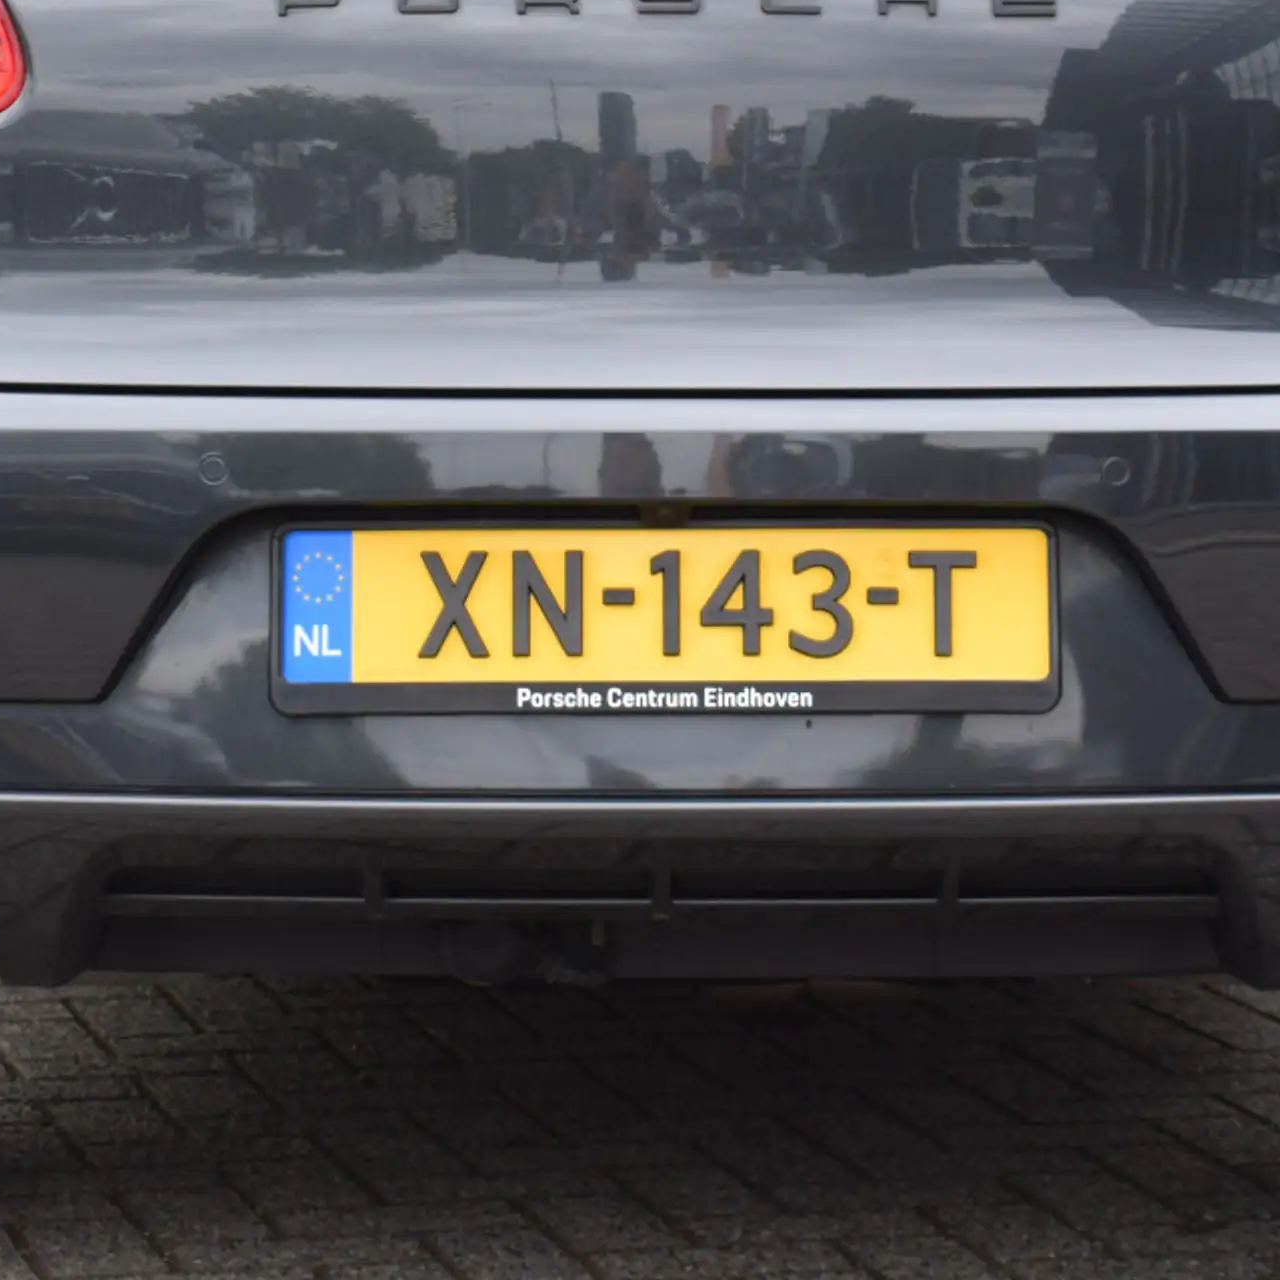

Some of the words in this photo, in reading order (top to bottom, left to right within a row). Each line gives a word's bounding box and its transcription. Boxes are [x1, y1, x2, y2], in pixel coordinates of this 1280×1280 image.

[418, 549, 977, 658] XN-143-T
[293, 625, 341, 656] NL
[516, 687, 602, 708] Porsche
[607, 687, 699, 708] Centrum
[704, 687, 813, 708] Eindhoven
